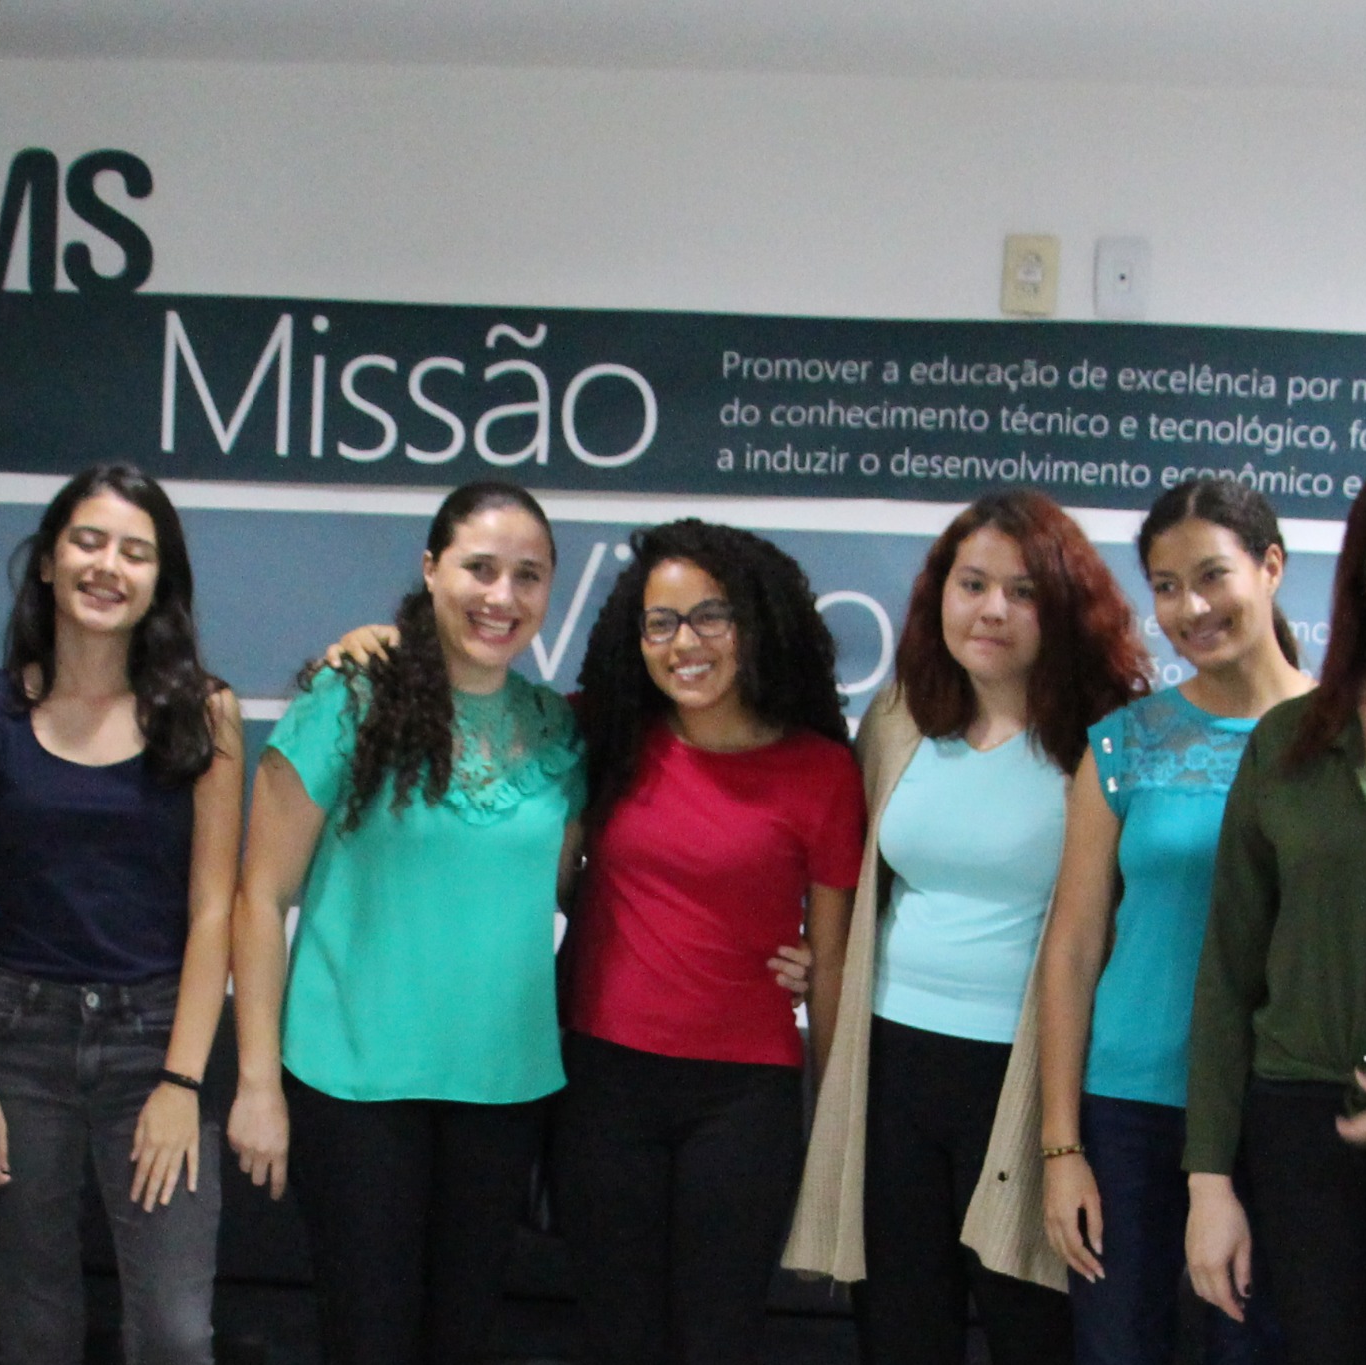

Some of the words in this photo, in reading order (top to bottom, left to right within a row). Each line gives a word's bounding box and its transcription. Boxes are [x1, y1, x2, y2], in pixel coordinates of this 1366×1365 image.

[160, 310, 660, 468] Missão
[722, 350, 873, 384] Promover
[881, 360, 900, 384] a
[909, 355, 1060, 393] educação
[1067, 358, 1108, 391] de
[1117, 363, 1277, 399] excelência
[1285, 377, 1340, 405] por
[719, 397, 761, 427] do
[769, 398, 990, 433] conhecimento
[1000, 403, 1110, 438] técnico
[1118, 415, 1139, 439] e
[1149, 413, 1337, 455] tecnológico,
[716, 447, 734, 472] a
[744, 442, 850, 474] induzir
[859, 452, 881, 476] o
[889, 447, 1152, 489] desenvolvimento
